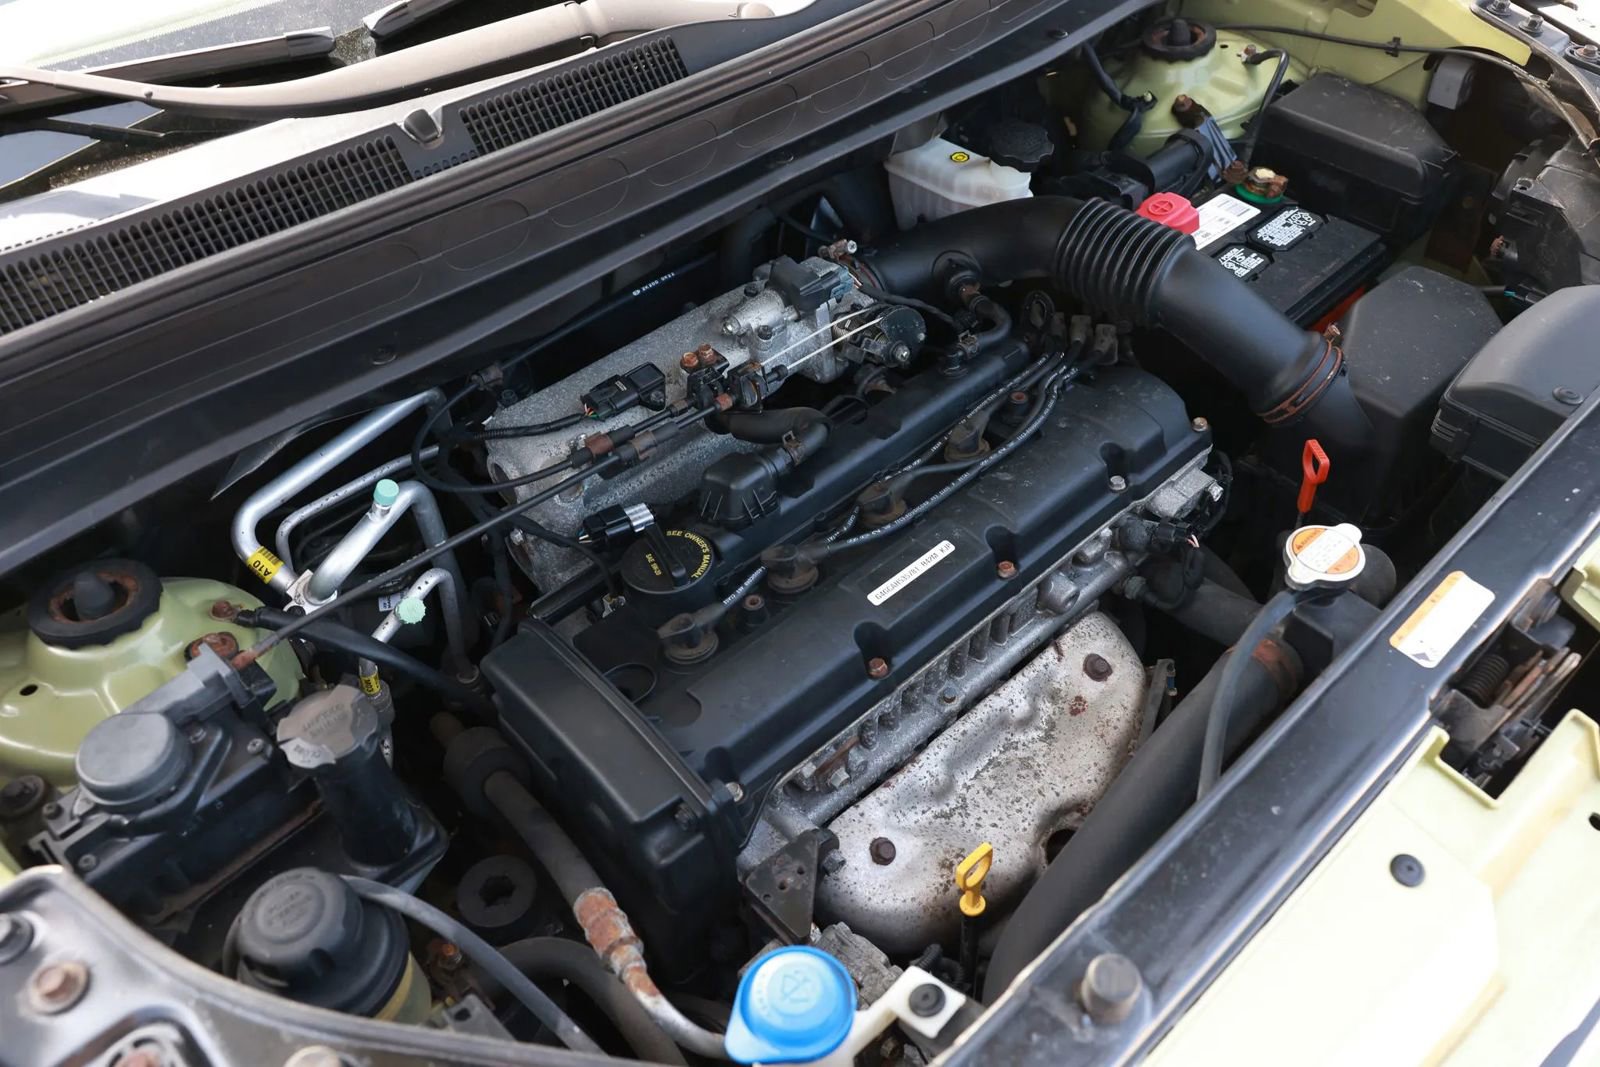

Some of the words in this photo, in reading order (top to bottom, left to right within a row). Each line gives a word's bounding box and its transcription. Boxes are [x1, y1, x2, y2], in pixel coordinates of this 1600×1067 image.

[684, 532, 710, 554] OWNER'S
[252, 559, 273, 577] A10
[690, 554, 711, 578] MANUAL
